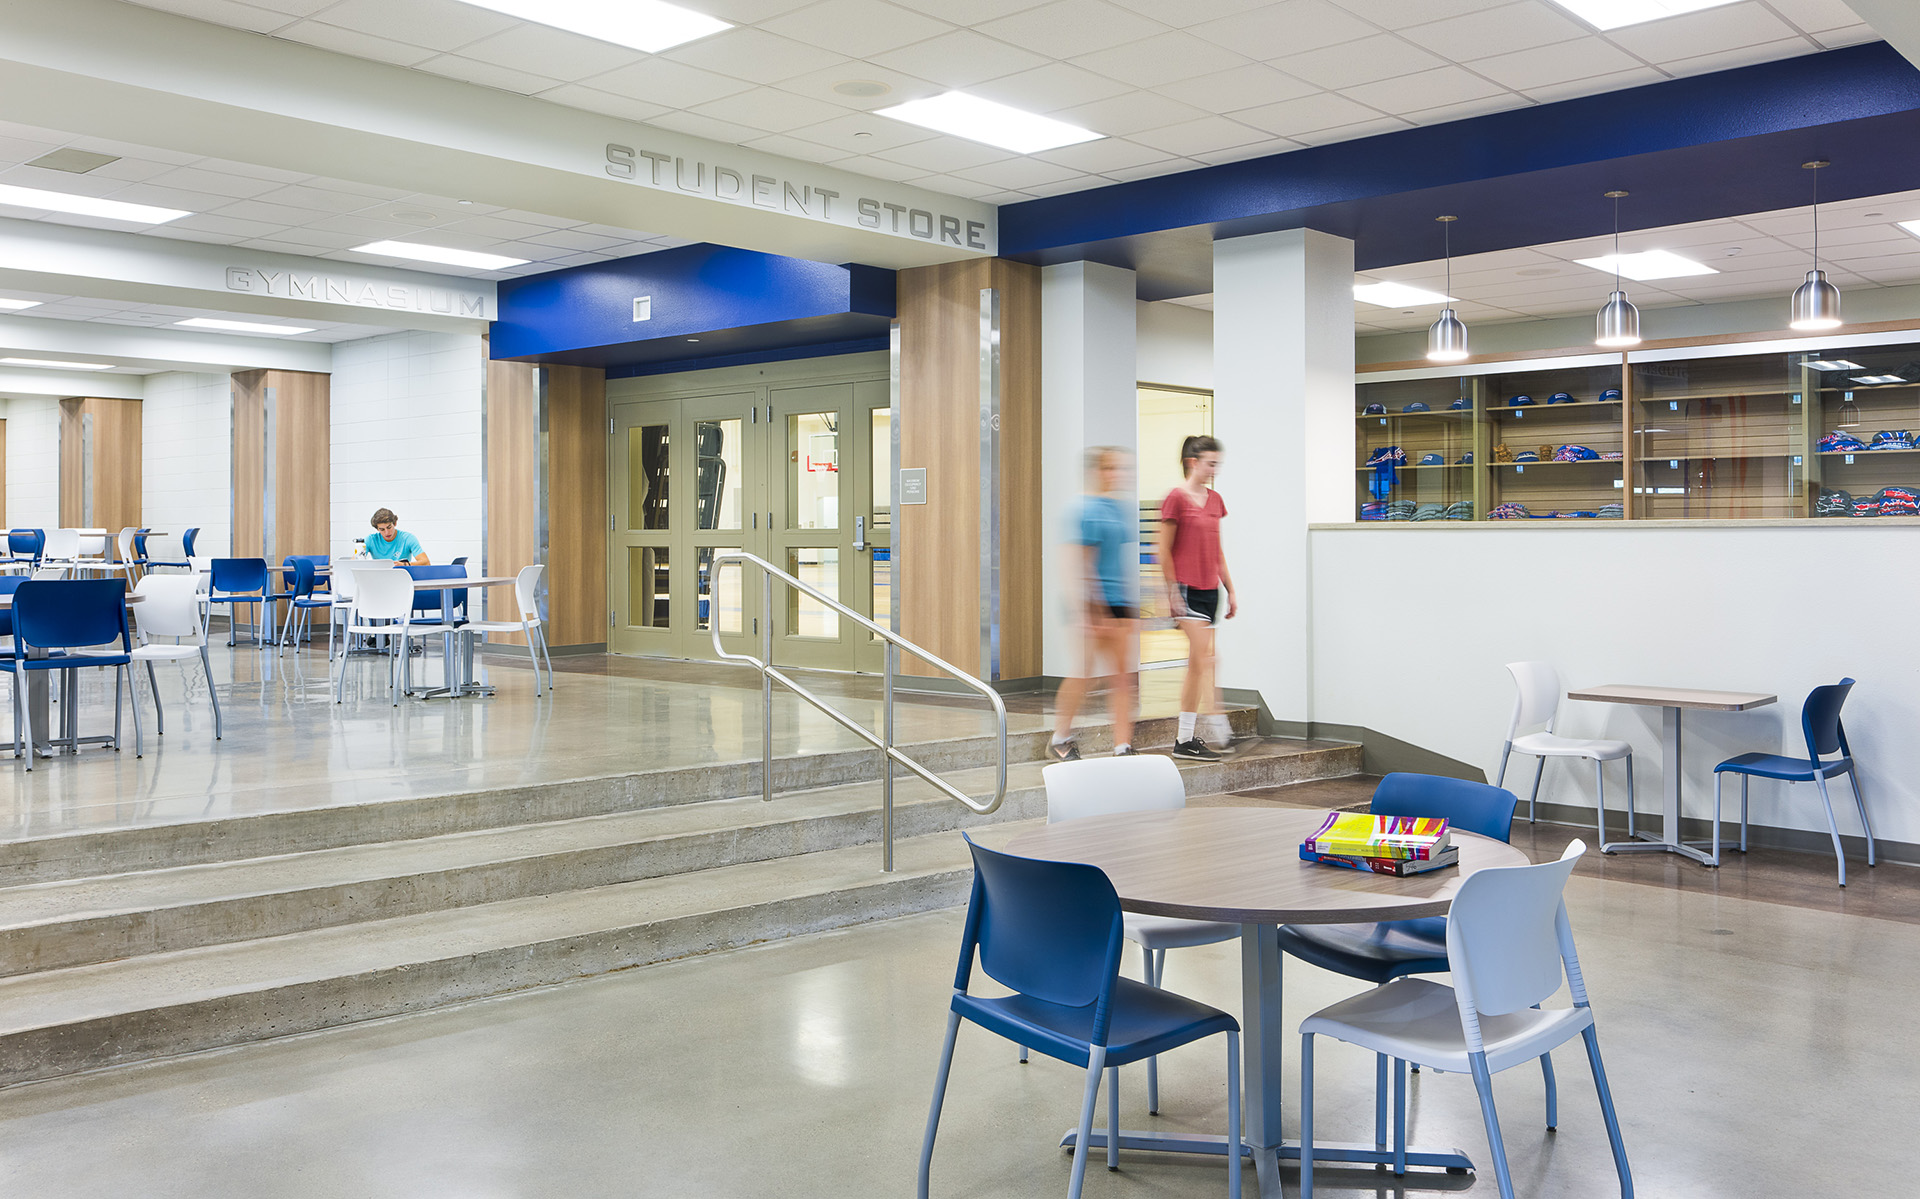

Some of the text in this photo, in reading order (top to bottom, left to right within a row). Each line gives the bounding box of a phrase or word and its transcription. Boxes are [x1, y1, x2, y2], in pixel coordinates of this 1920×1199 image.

[605, 142, 986, 250] STUDENT STORE
[226, 266, 484, 317] GYMNASIUM
